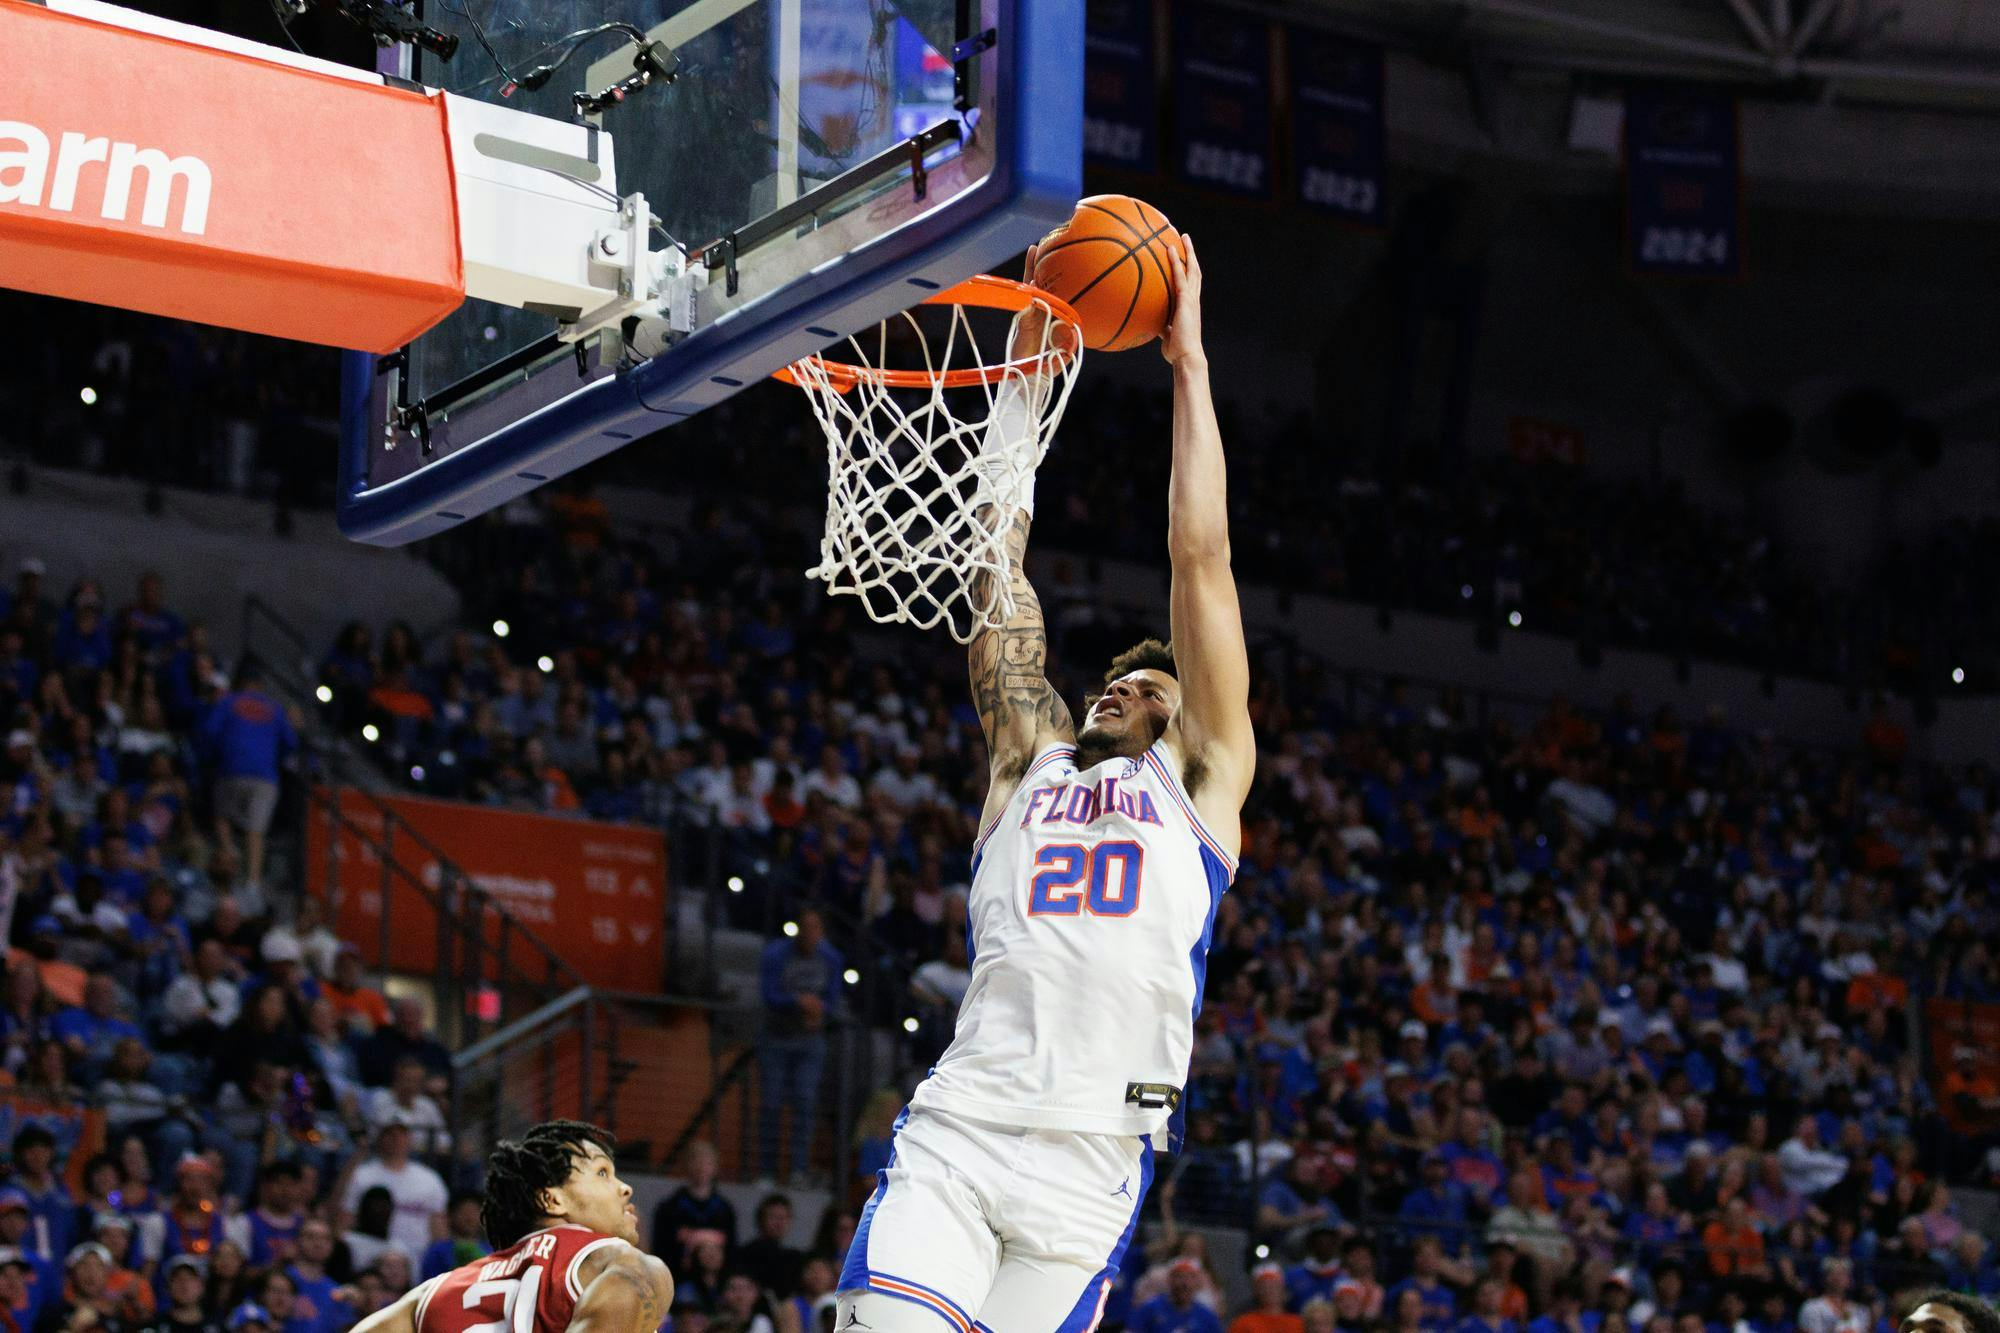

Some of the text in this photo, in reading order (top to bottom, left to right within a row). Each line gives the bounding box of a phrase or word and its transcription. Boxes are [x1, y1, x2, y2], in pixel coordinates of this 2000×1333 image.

[1641, 225, 1729, 265] 2024
[1020, 778, 1165, 829] FLORIDA
[1028, 840, 1144, 918] 20
